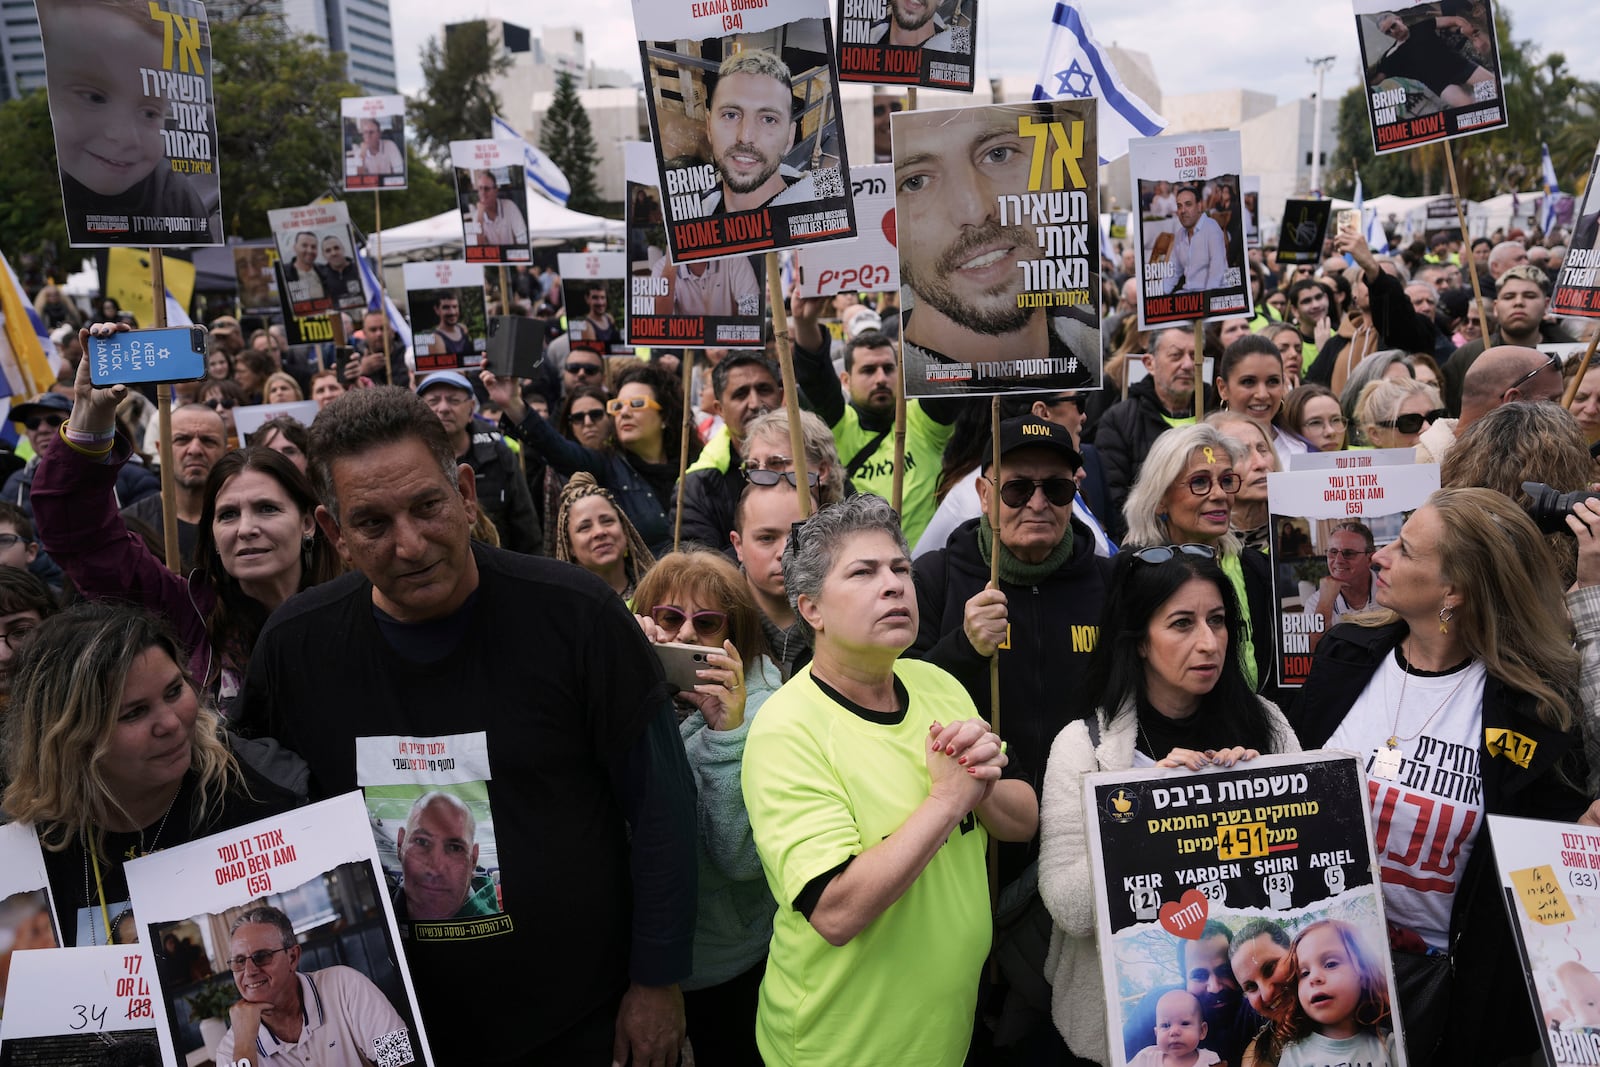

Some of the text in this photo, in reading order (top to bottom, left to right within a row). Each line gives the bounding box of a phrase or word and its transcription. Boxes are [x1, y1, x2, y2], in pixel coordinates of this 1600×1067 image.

[692, 0, 729, 18] ELKANA
[844, 0, 887, 19] BRING
[722, 13, 743, 32] (34)
[843, 20, 870, 43] HIM
[148, 1, 205, 75] אל
[842, 47, 922, 74] HOME NOW!
[139, 67, 206, 104] תשאירו
[1372, 87, 1406, 109] BRING
[171, 101, 209, 132] אותי
[1374, 108, 1397, 126] HIM
[1377, 112, 1445, 143] HOME NOW!
[160, 129, 210, 160] מאחור
[1018, 116, 1087, 191] אל
[171, 159, 212, 174] אריאל ביבס
[665, 164, 716, 195] BRING
[670, 194, 704, 221] HIM
[998, 191, 1088, 227] תשאירו
[674, 208, 773, 250] HOME NOW!
[789, 217, 850, 236] FAMILIES FORUM
[1036, 224, 1090, 257] אותי
[1017, 257, 1090, 291] מאחור
[1144, 262, 1174, 280] BRING
[1562, 268, 1596, 287] THEM
[632, 276, 669, 296] BRING
[1145, 279, 1164, 297] HIM
[632, 296, 655, 315] HIM
[1017, 290, 1090, 308] אלקנה בוחבוט
[1146, 297, 1174, 316] HOME
[1174, 292, 1204, 312] NOW!
[1555, 287, 1591, 308] HOME
[632, 316, 704, 337] HOME NOW!
[96, 339, 109, 377] HAMAS
[111, 343, 122, 371] FUCK
[130, 341, 142, 370] CALM
[144, 342, 155, 367] KEEP
[976, 357, 1078, 380] #עדהחטוףהאחרון
[1022, 424, 1053, 437] NOW.
[1336, 456, 1372, 469] אוהד בן עמי
[1328, 474, 1378, 489] אוהד בן עמי
[1324, 487, 1384, 502] OHAD BEN AMI
[1345, 501, 1363, 515] (55)
[1282, 613, 1324, 633] BRING
[1283, 634, 1310, 654] HIM
[1284, 656, 1313, 676] HOM
[1152, 772, 1309, 810] משפחת ביבס
[1430, 768, 1481, 806] אותם
[1212, 809, 1253, 826] בשבי
[1255, 800, 1319, 822] מוחזקים
[1147, 815, 1210, 834] החמאס
[217, 828, 285, 863] אוהד בן עמי
[1177, 837, 1219, 855] ימים!
[1266, 827, 1298, 844] מעל
[1561, 832, 1586, 851] ביבס
[215, 844, 297, 886] OHAD BEN AMI
[1561, 850, 1588, 868] SHIRI
[1123, 849, 1356, 892] KEIR YARDEN SHIRI ARIEL
[1569, 870, 1598, 891] (33)
[247, 872, 272, 897] (55)
[1129, 889, 1161, 912] (2)
[1263, 873, 1294, 895] (33)
[1324, 866, 1346, 889] (5)
[501, 918, 510, 928] די
[1169, 901, 1204, 931] חזרתי
[124, 954, 142, 975] לוי
[116, 978, 134, 997] OR
[69, 1004, 108, 1030] 34
